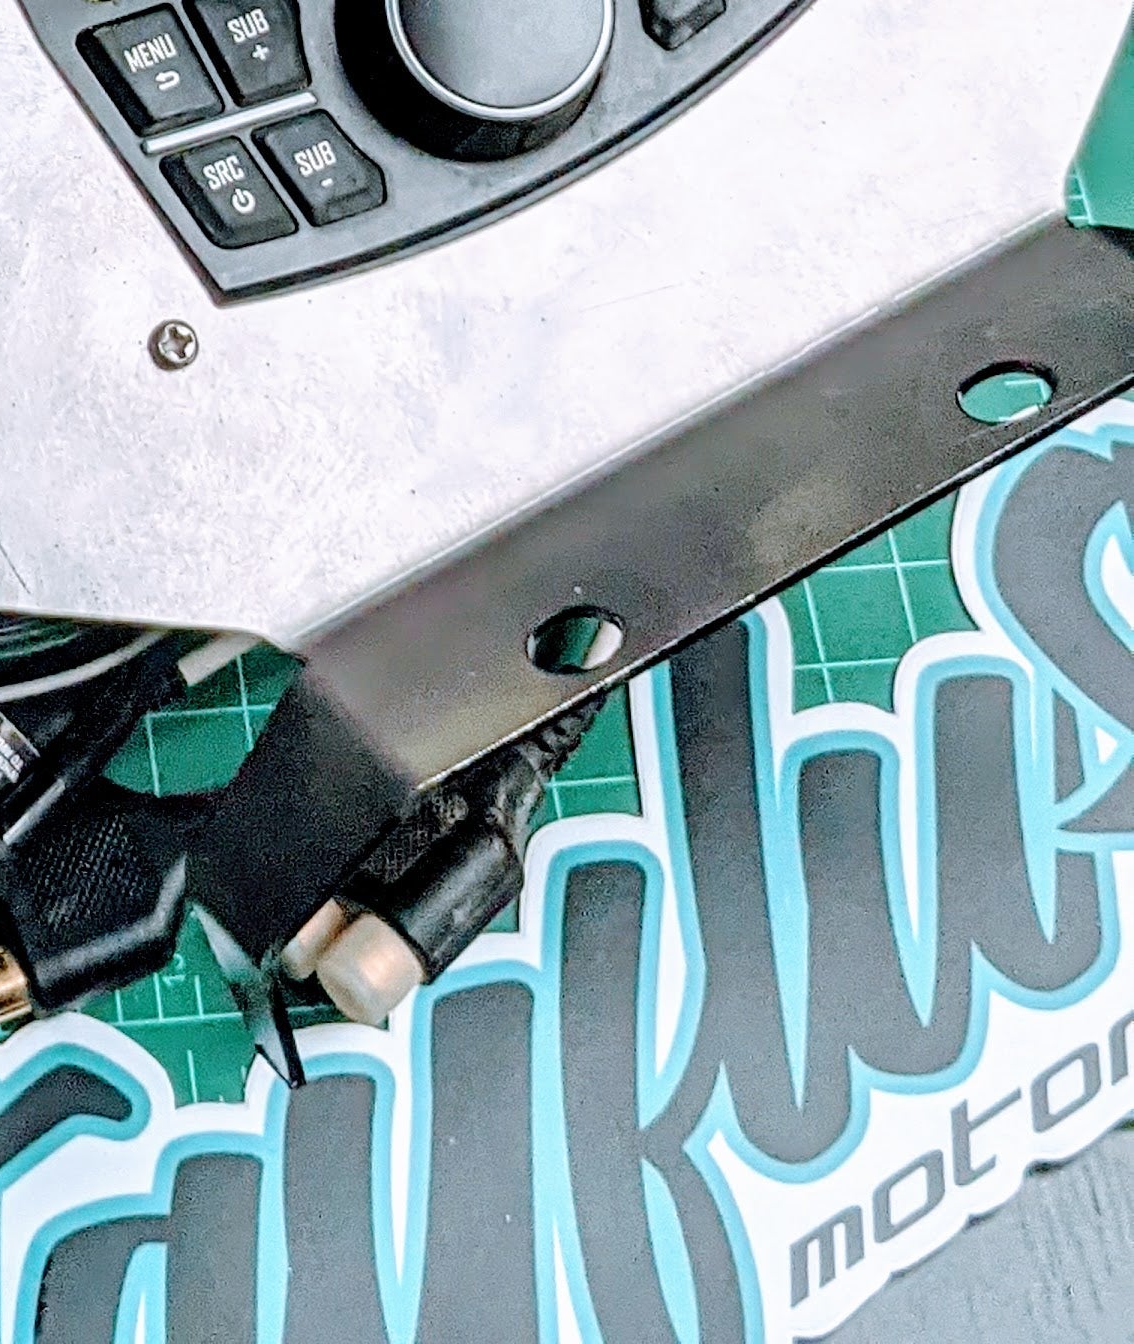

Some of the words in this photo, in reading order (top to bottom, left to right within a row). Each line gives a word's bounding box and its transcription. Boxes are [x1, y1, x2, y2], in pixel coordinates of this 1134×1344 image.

[227, 8, 270, 44] SUB
[122, 32, 177, 74] MENU
[202, 154, 246, 188] SRC
[294, 140, 337, 178] SUB
